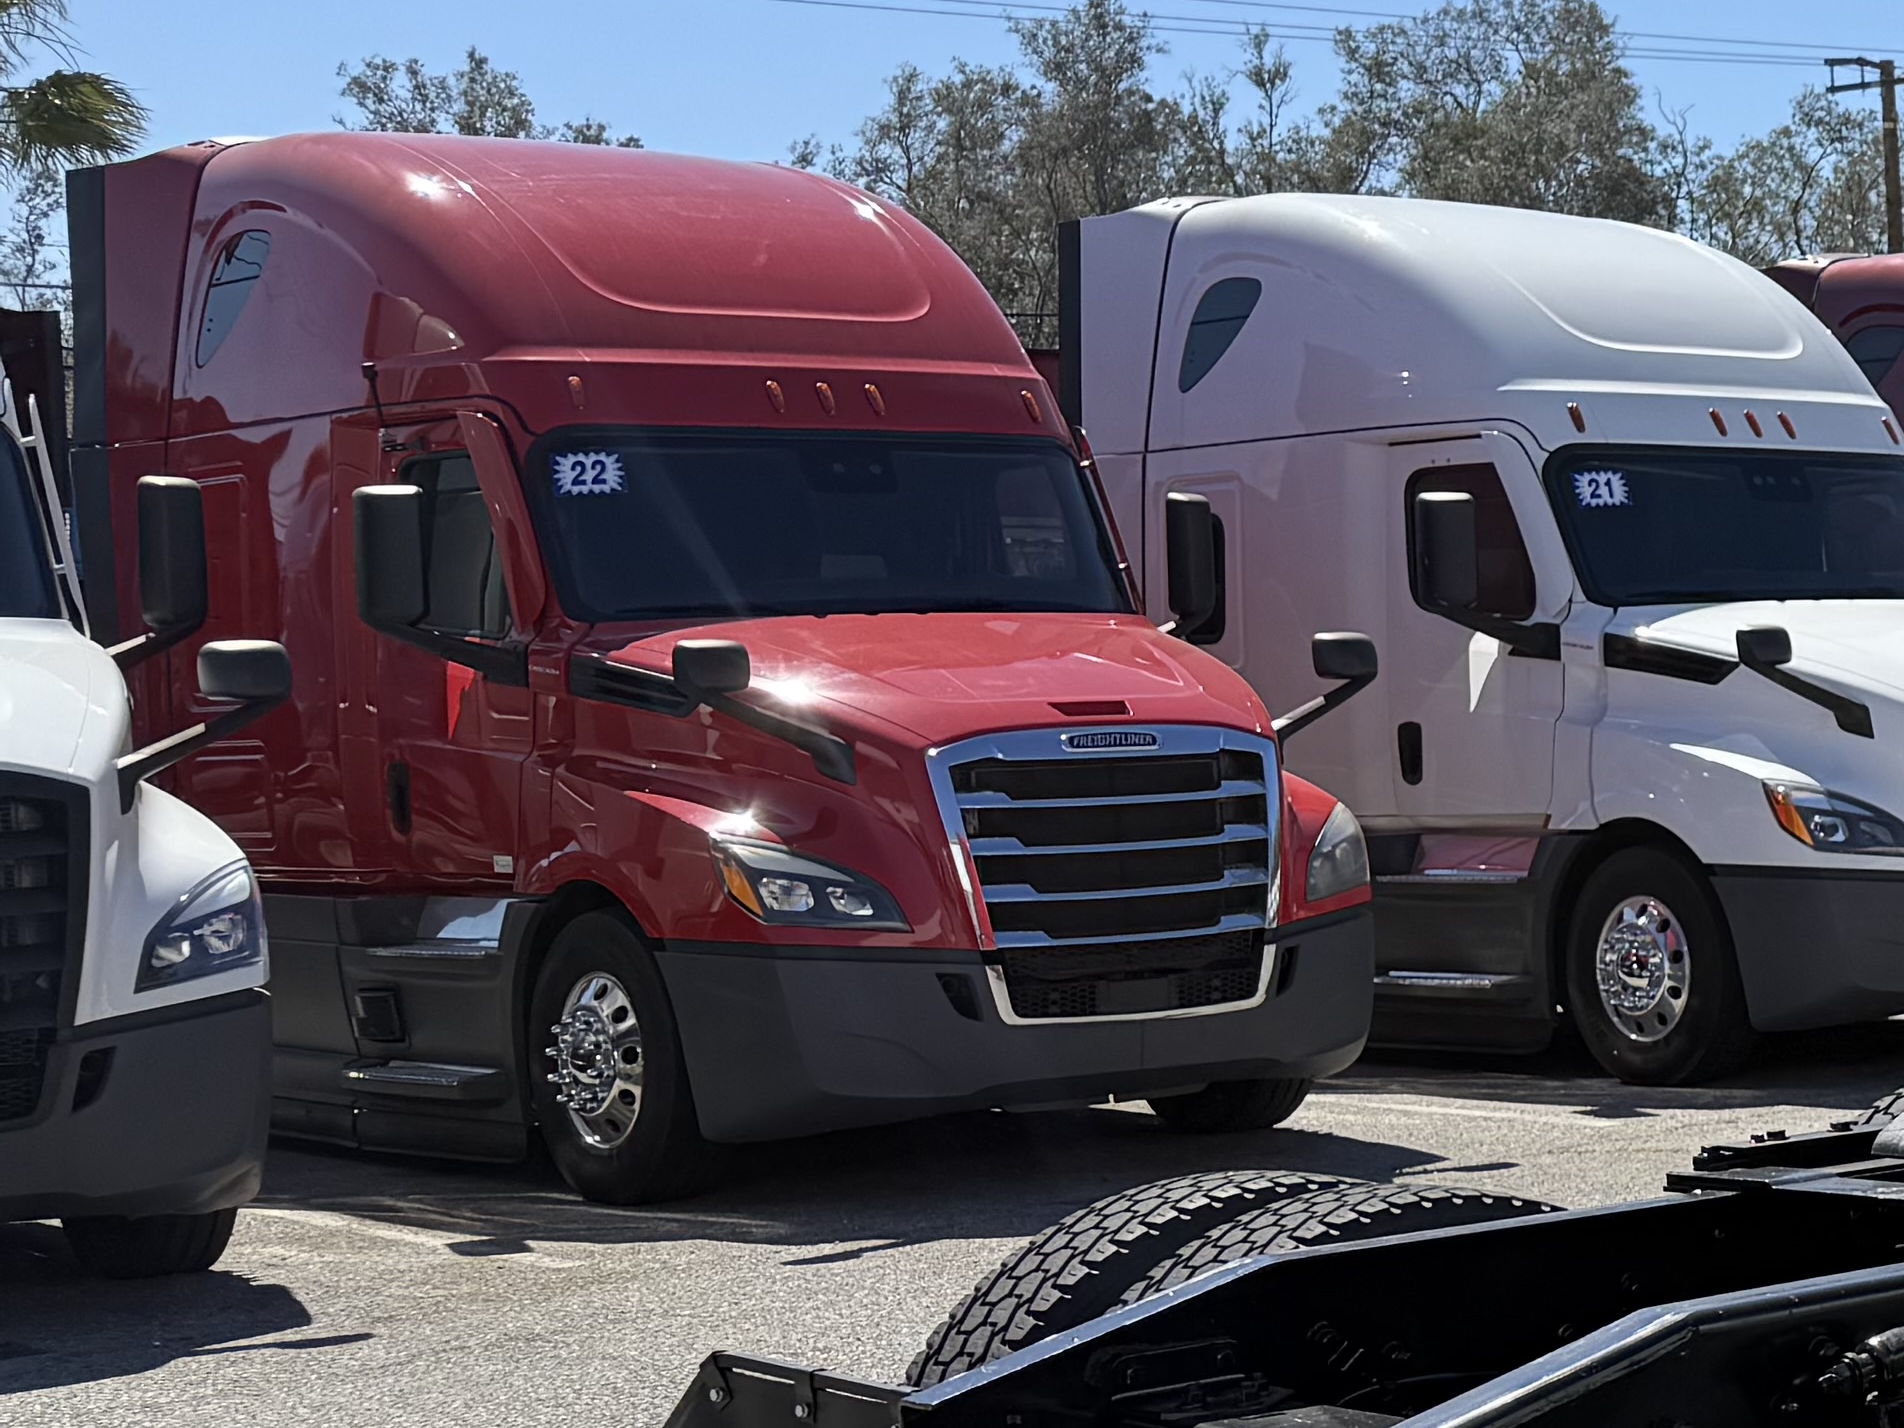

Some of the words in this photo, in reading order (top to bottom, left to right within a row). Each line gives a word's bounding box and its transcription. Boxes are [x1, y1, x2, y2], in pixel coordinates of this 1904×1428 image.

[571, 460, 607, 486] 22
[1588, 477, 1613, 499] 21
[1073, 733, 1153, 747] FREIGHTLINER
